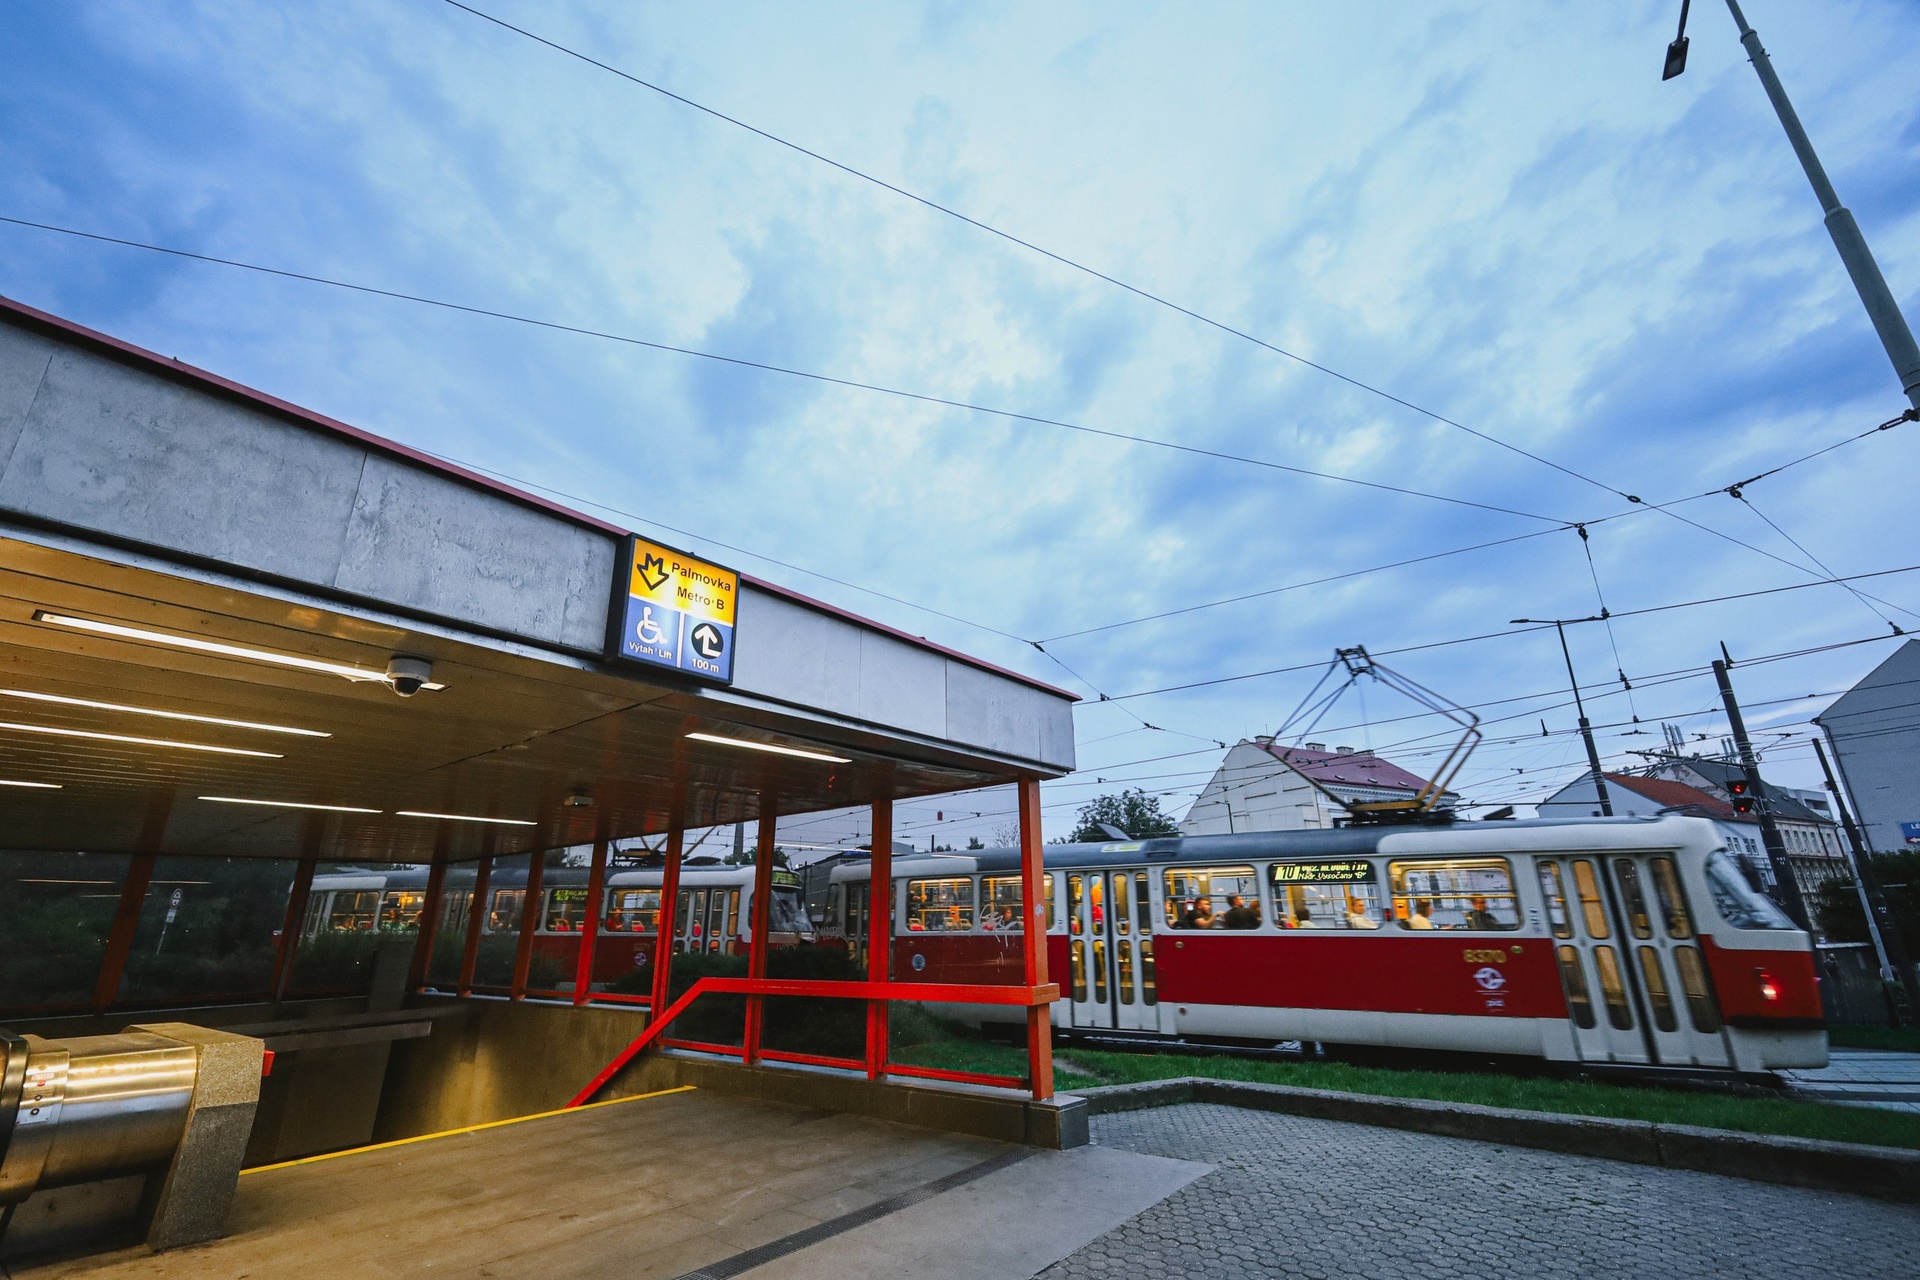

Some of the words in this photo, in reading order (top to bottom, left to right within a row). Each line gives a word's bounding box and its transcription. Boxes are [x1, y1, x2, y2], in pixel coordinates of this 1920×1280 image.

[671, 562, 731, 592] Palmovka
[677, 586, 711, 606] Metro
[716, 598, 725, 610] B
[629, 641, 653, 655] Výtah
[658, 648, 673, 660] Lift
[692, 658, 709, 670] 100
[710, 663, 719, 673] m
